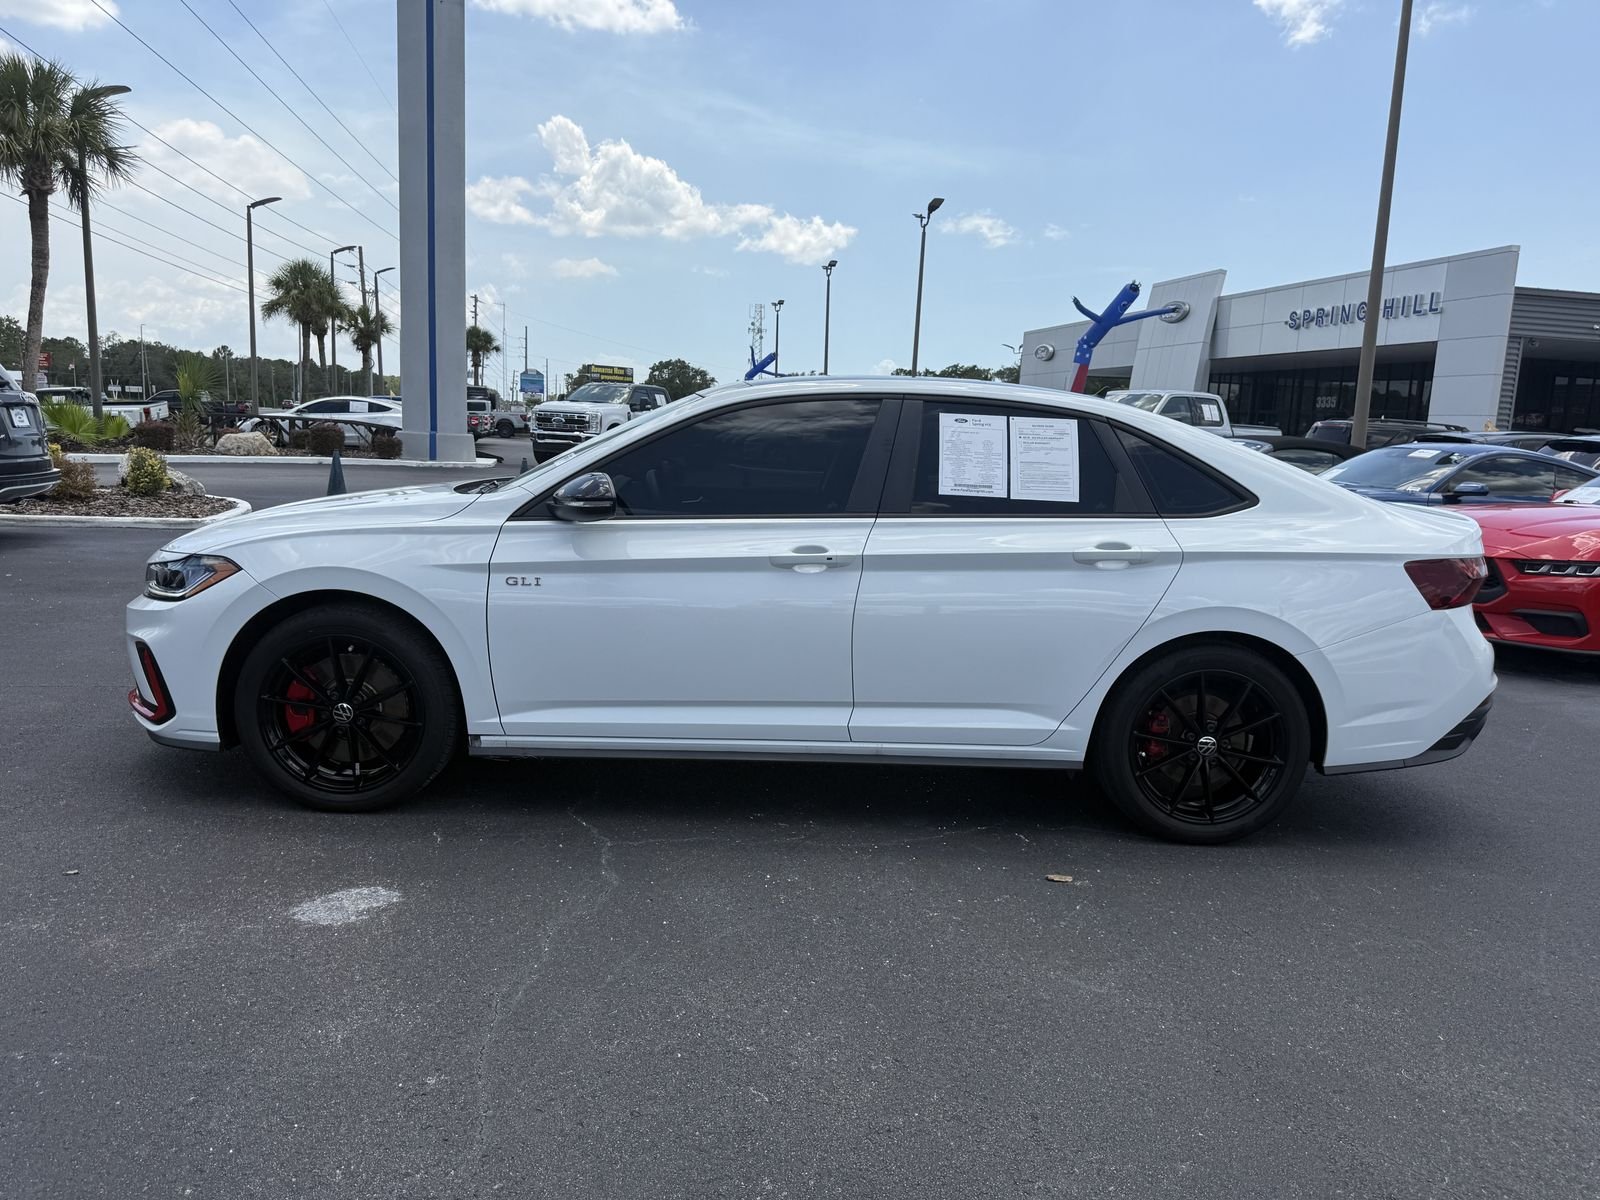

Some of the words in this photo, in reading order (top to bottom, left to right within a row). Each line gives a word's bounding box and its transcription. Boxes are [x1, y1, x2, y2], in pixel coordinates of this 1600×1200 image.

[1288, 301, 1368, 329] SPRING
[1382, 291, 1441, 318] HILL
[1316, 396, 1337, 408] 3335
[505, 576, 542, 587] GLI
